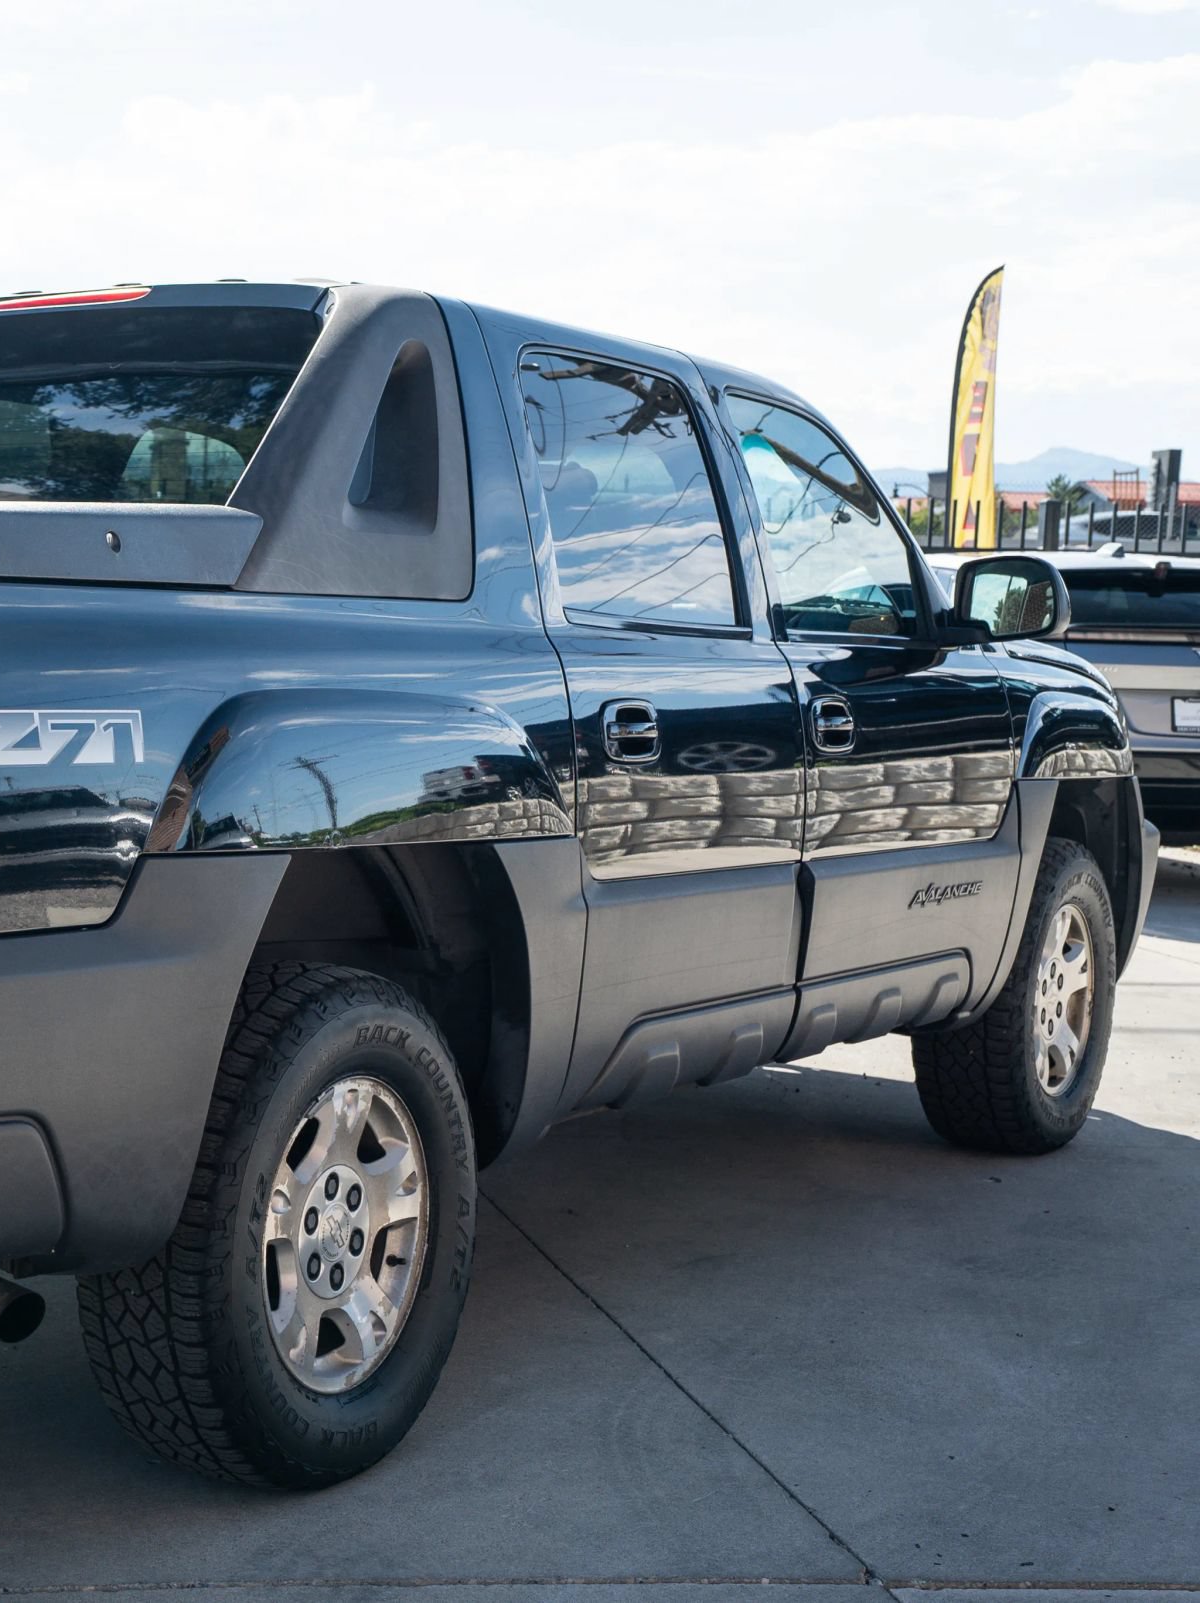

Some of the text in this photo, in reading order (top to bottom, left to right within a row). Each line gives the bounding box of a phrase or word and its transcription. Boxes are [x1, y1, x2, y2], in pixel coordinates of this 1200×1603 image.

[908, 880, 984, 909] AVALANCHE
[353, 1025, 410, 1050] BACK
[416, 1047, 469, 1175] COUNTRY
